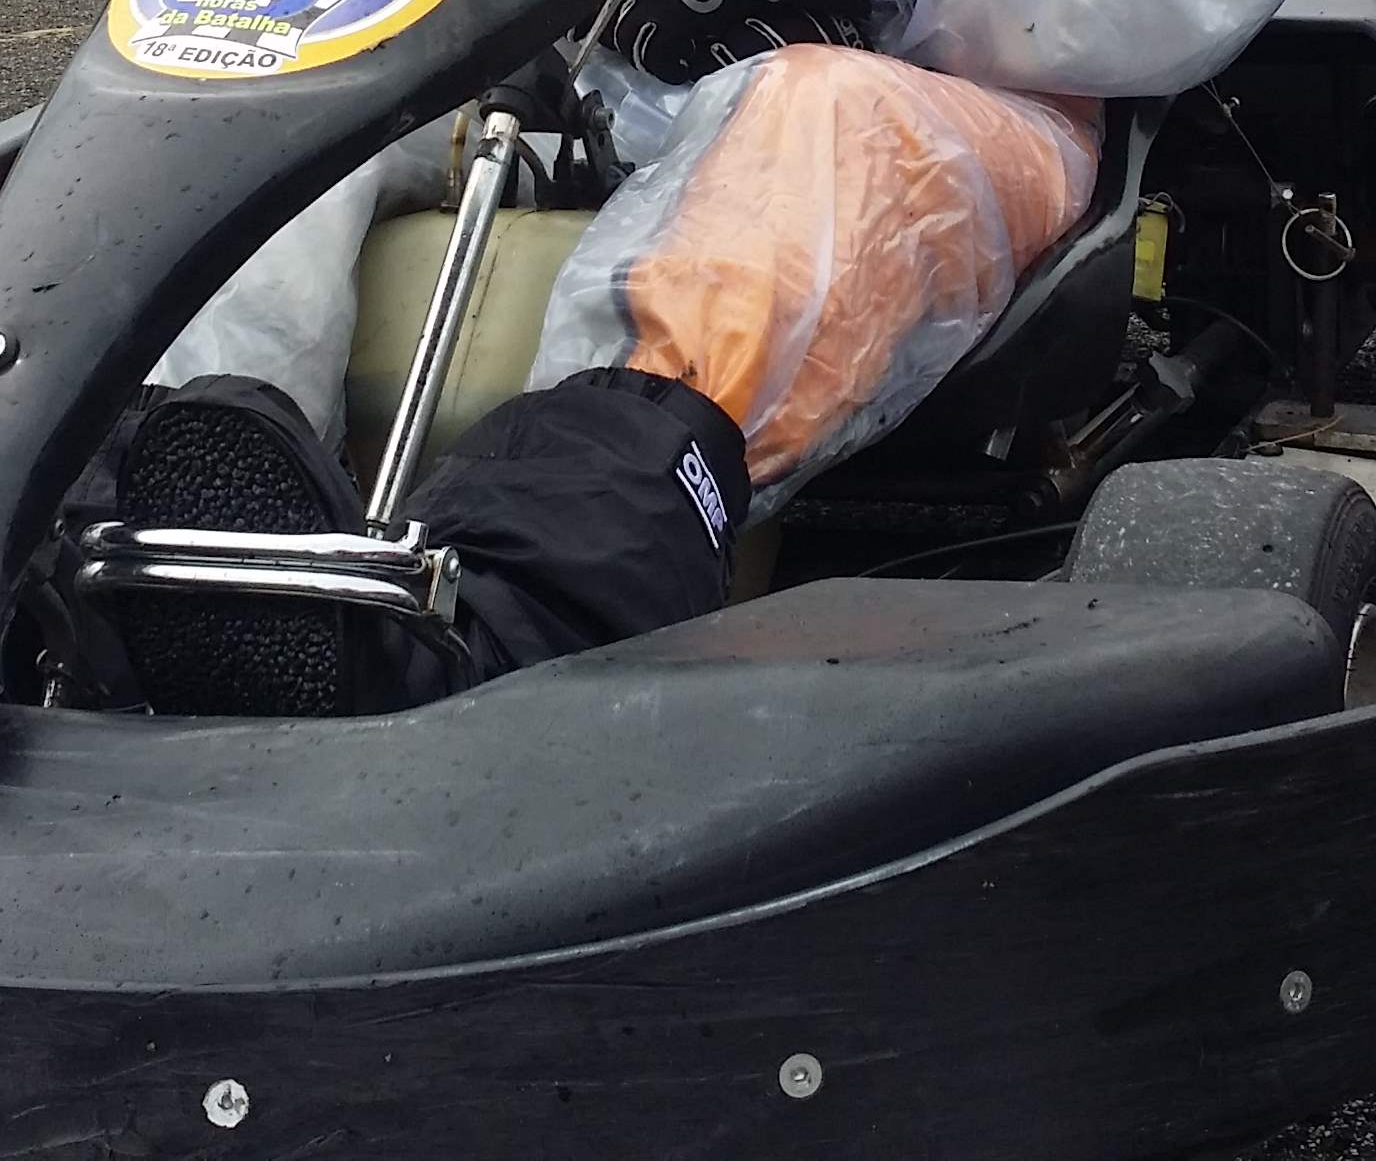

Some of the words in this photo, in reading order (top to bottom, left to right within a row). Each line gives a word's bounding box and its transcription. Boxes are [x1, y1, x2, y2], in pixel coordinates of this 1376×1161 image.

[160, 9, 186, 26] da
[193, 9, 291, 36] Batalha
[143, 40, 176, 57] 18ª
[178, 47, 278, 69] EDIÇÃO
[682, 452, 724, 532] OMP
